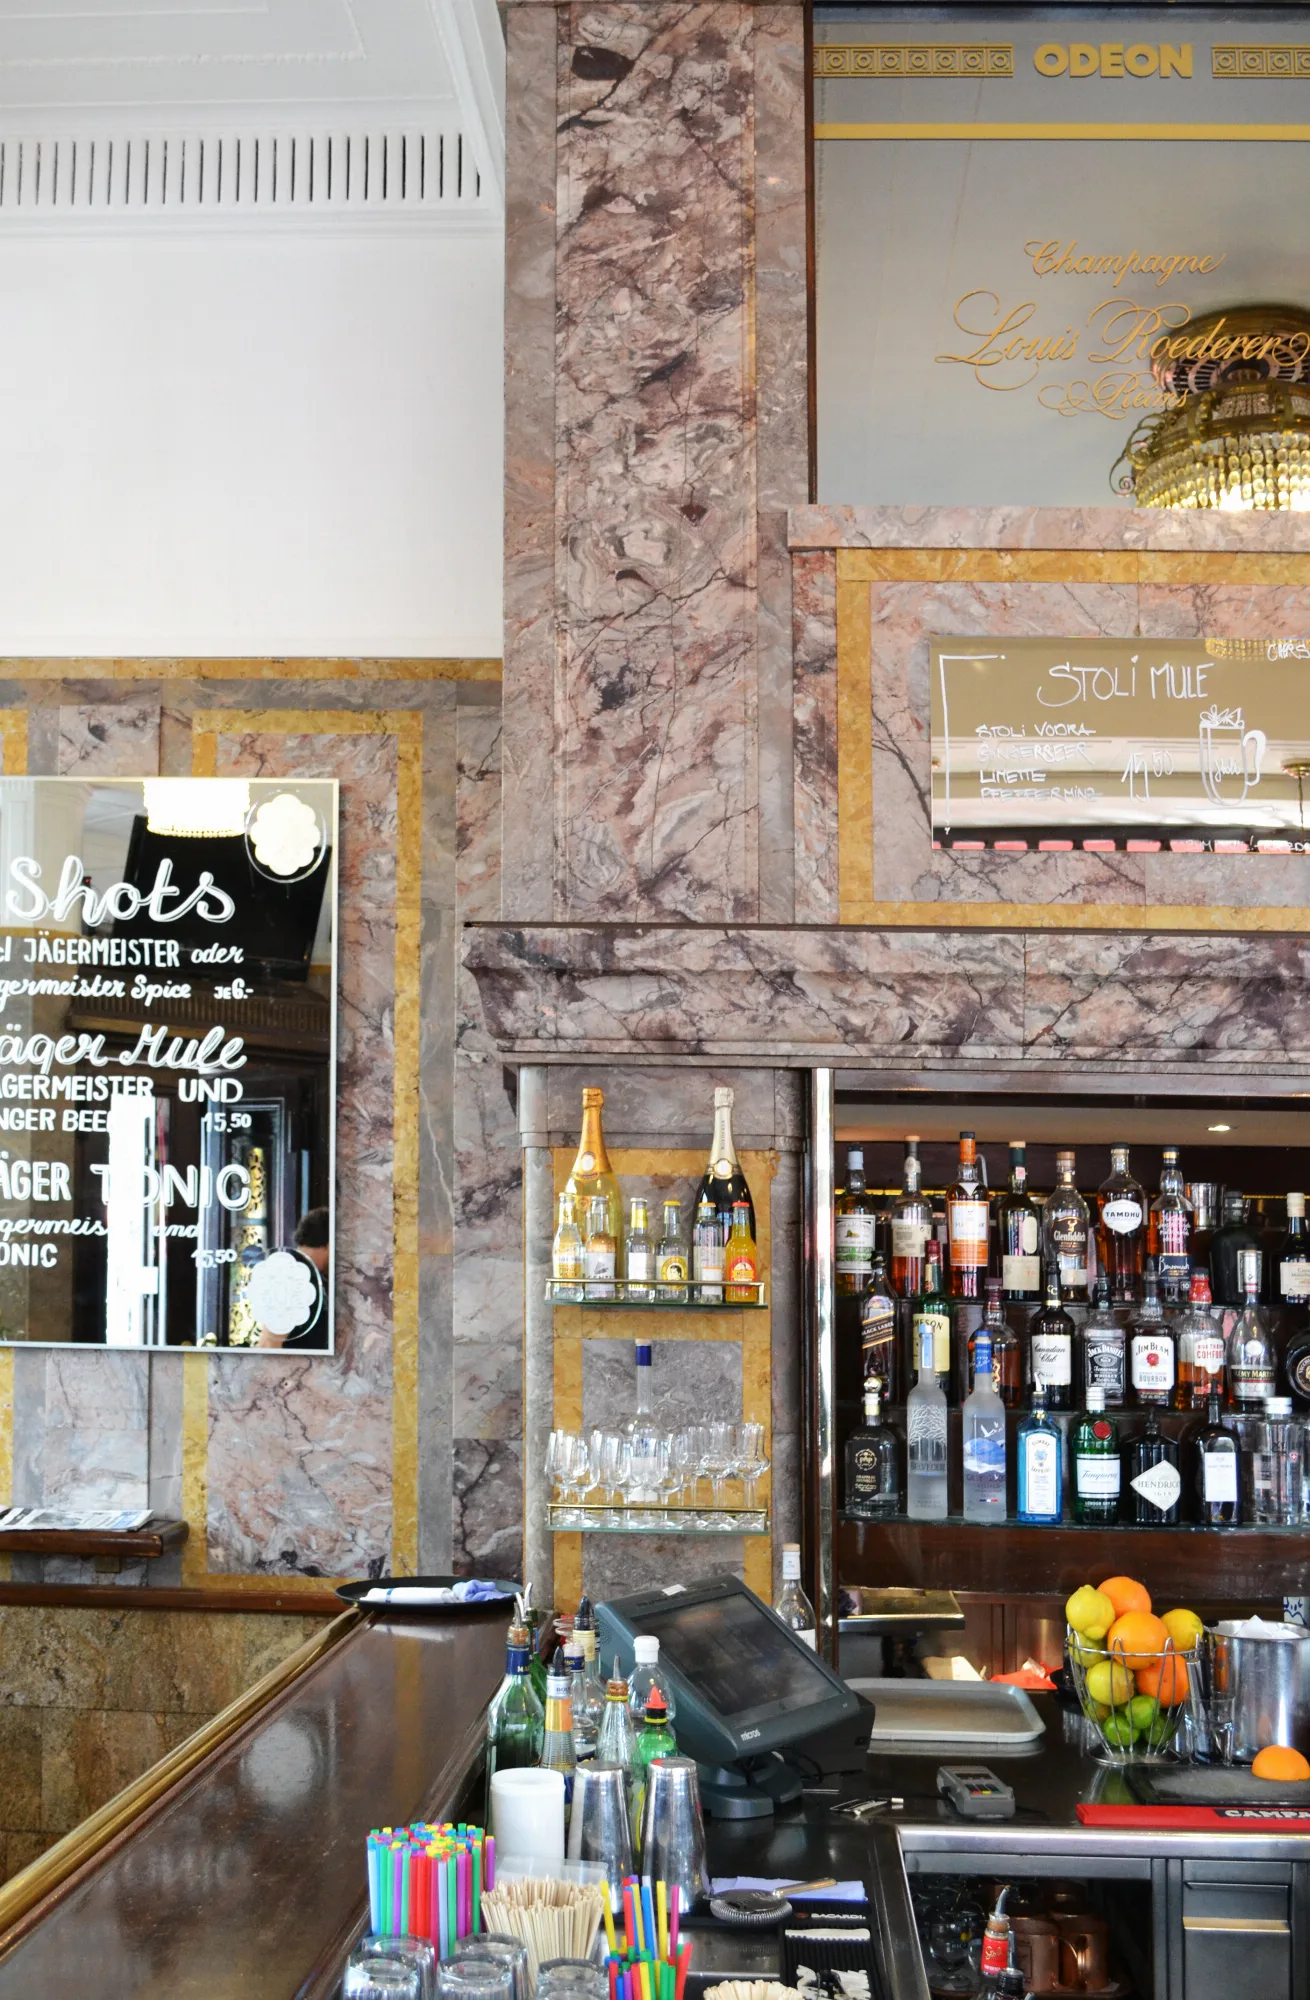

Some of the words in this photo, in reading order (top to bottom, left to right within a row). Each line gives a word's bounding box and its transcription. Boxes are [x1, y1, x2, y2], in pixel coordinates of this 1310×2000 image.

[1033, 43, 1193, 78] ODEON
[1024, 240, 1227, 287] Champagne
[935, 289, 1080, 391] Louis
[1087, 298, 1310, 367] Roederer
[1037, 371, 1189, 420] Reims
[1150, 662, 1214, 699] MULE
[7, 855, 235, 927] Shots
[24, 930, 180, 968] JÄGERMEISTER
[191, 942, 244, 964] oder
[130, 974, 192, 1007] Spice
[119, 1024, 248, 1069] Mule
[178, 1078, 244, 1103] UND
